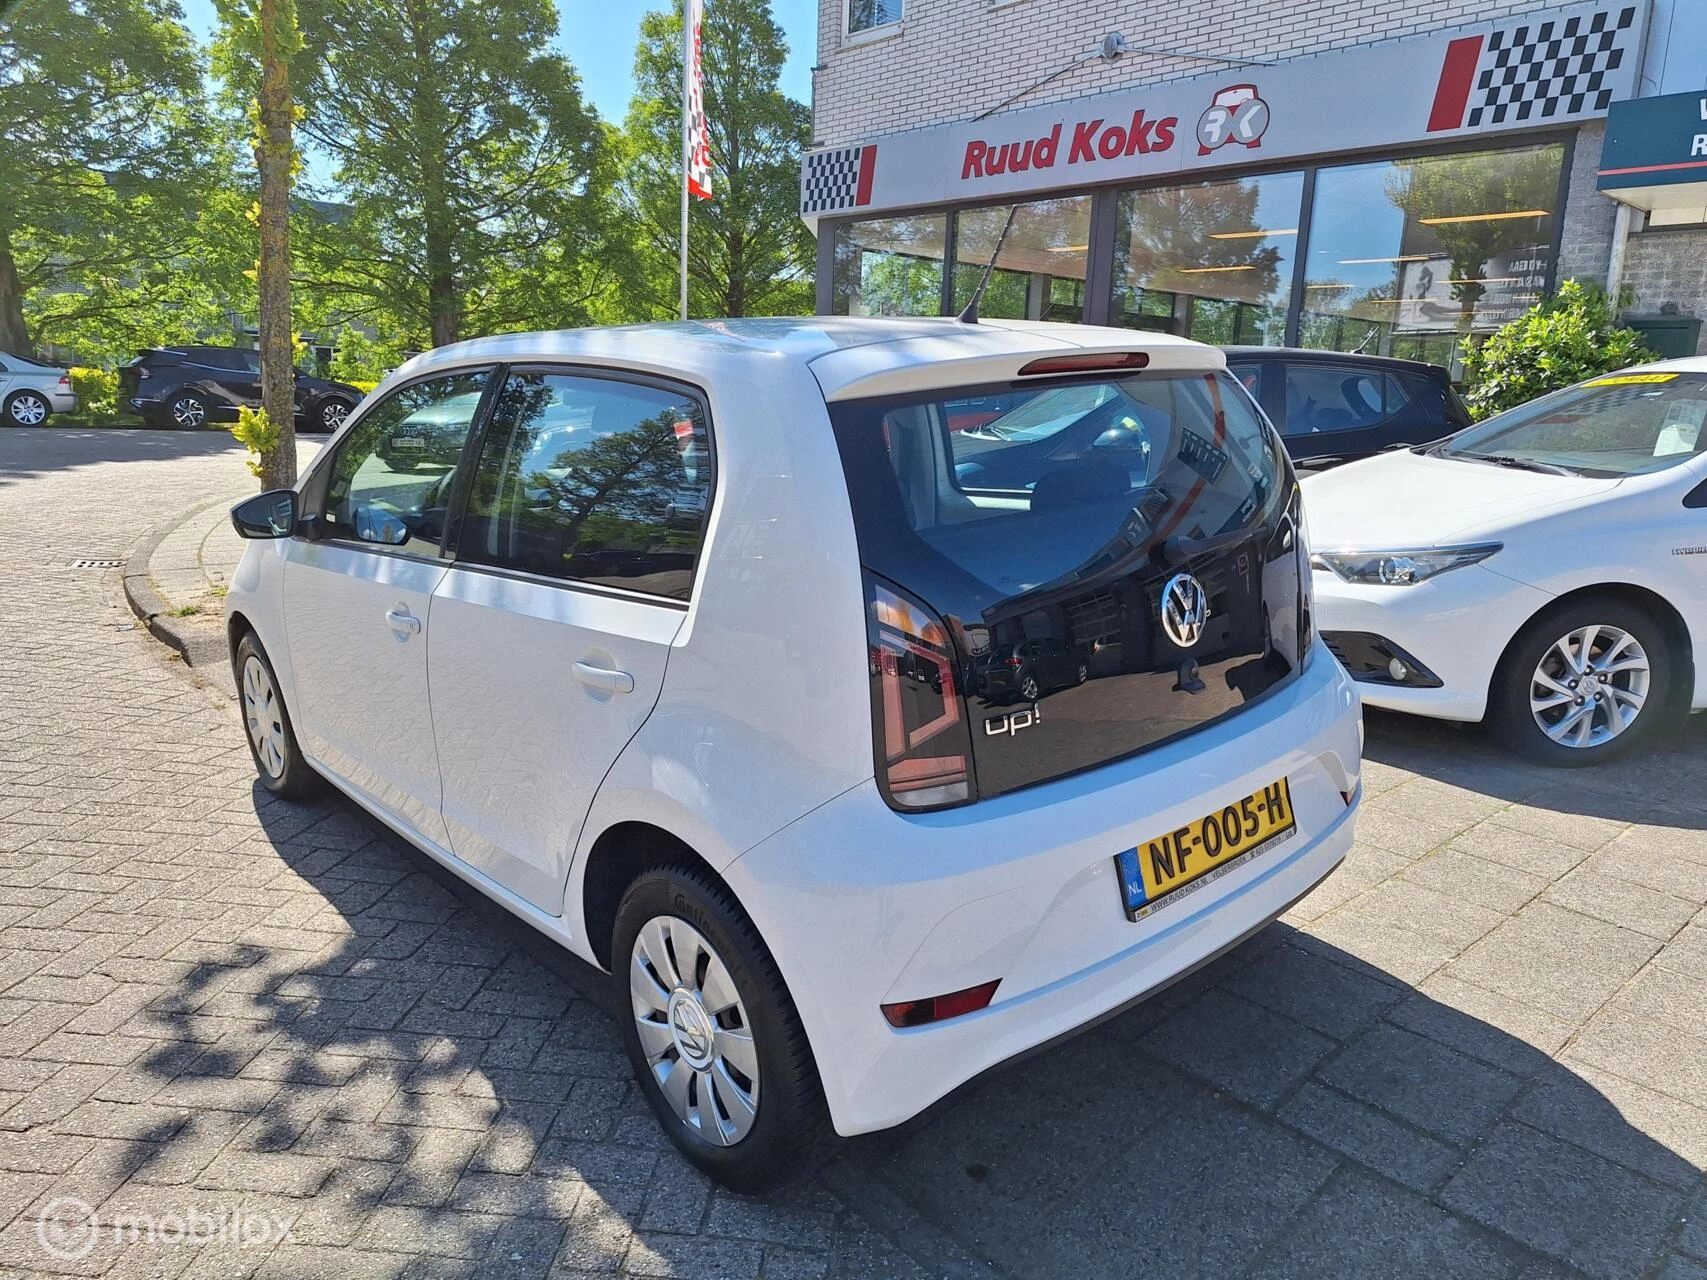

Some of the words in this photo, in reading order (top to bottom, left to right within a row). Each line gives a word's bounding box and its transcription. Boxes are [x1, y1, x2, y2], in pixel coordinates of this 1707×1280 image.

[961, 123, 1062, 180] Ruud
[1068, 109, 1178, 164] Koks
[985, 702, 1041, 737] up!
[1149, 781, 1286, 886] NF-005-H
[1127, 880, 1143, 897] NL
